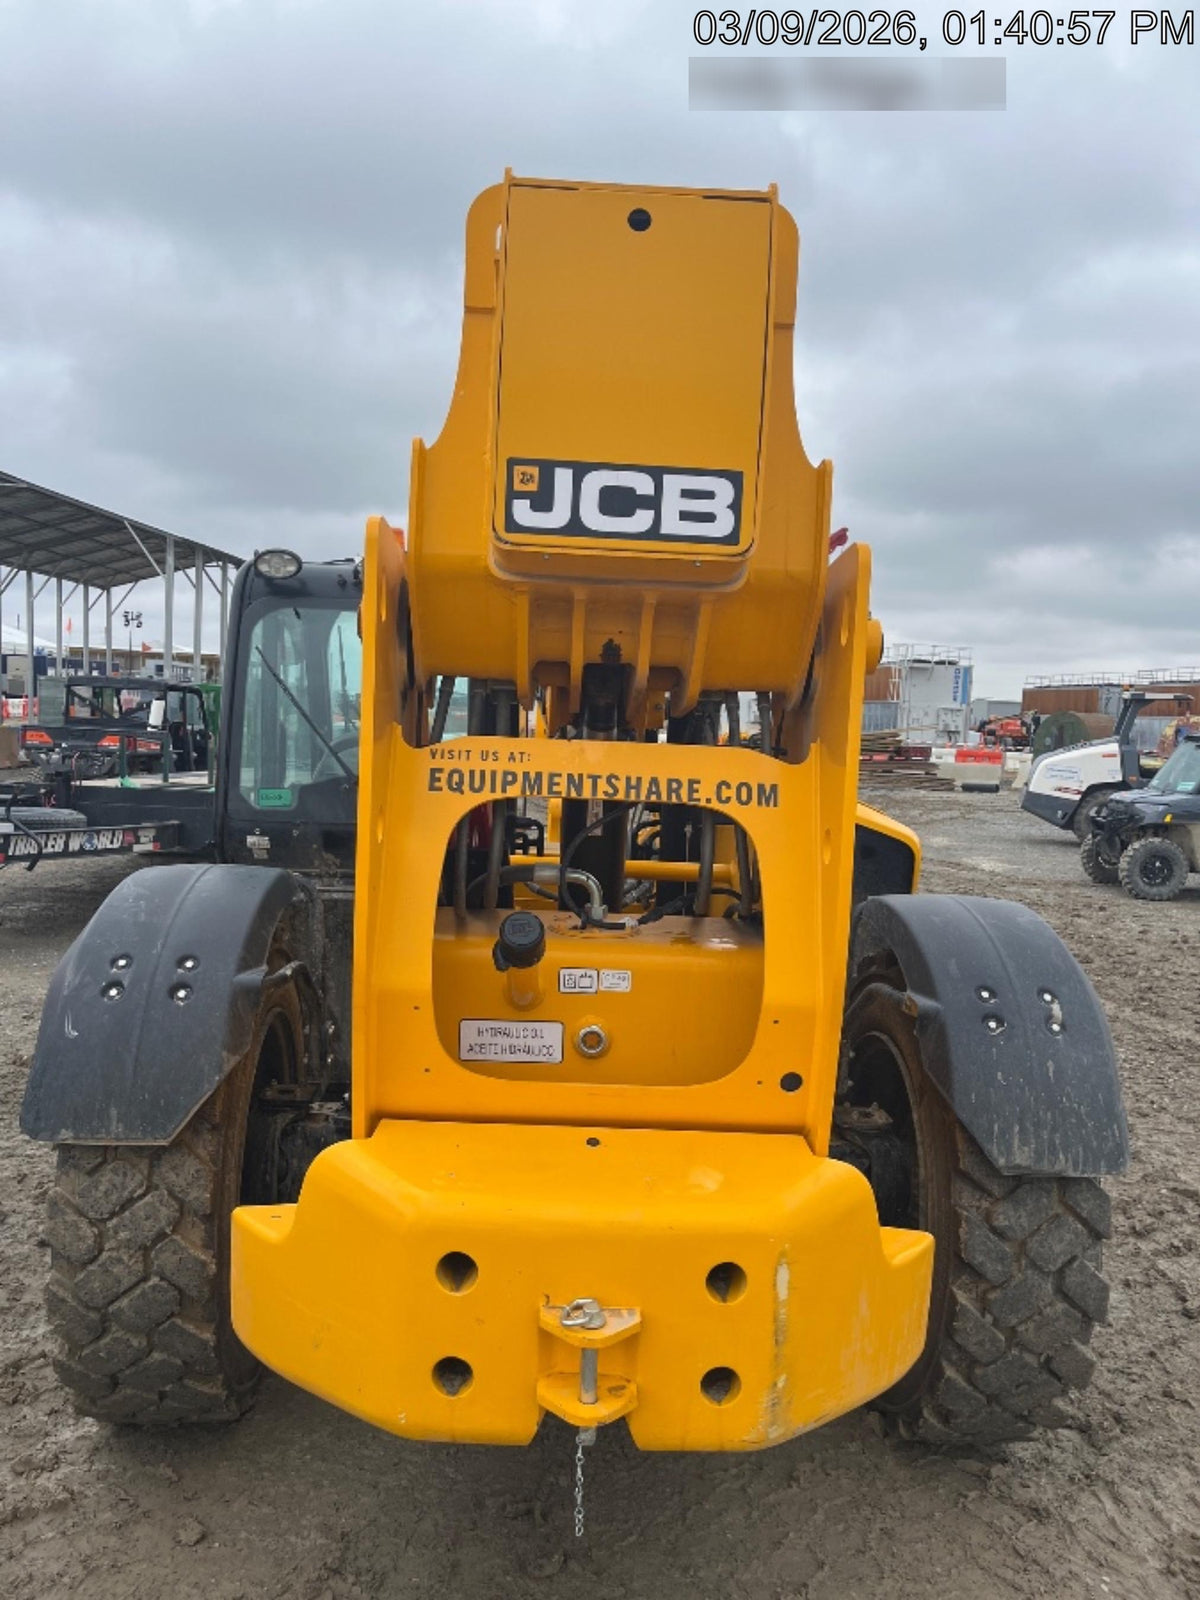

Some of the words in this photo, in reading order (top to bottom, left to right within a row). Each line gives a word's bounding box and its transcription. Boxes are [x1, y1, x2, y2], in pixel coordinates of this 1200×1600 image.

[512, 466, 736, 538] JCB
[430, 748, 472, 760] VISIT
[481, 749, 499, 761] US
[508, 751, 531, 763] AT:
[428, 767, 780, 808] EQUIPMENTSHARE.COM
